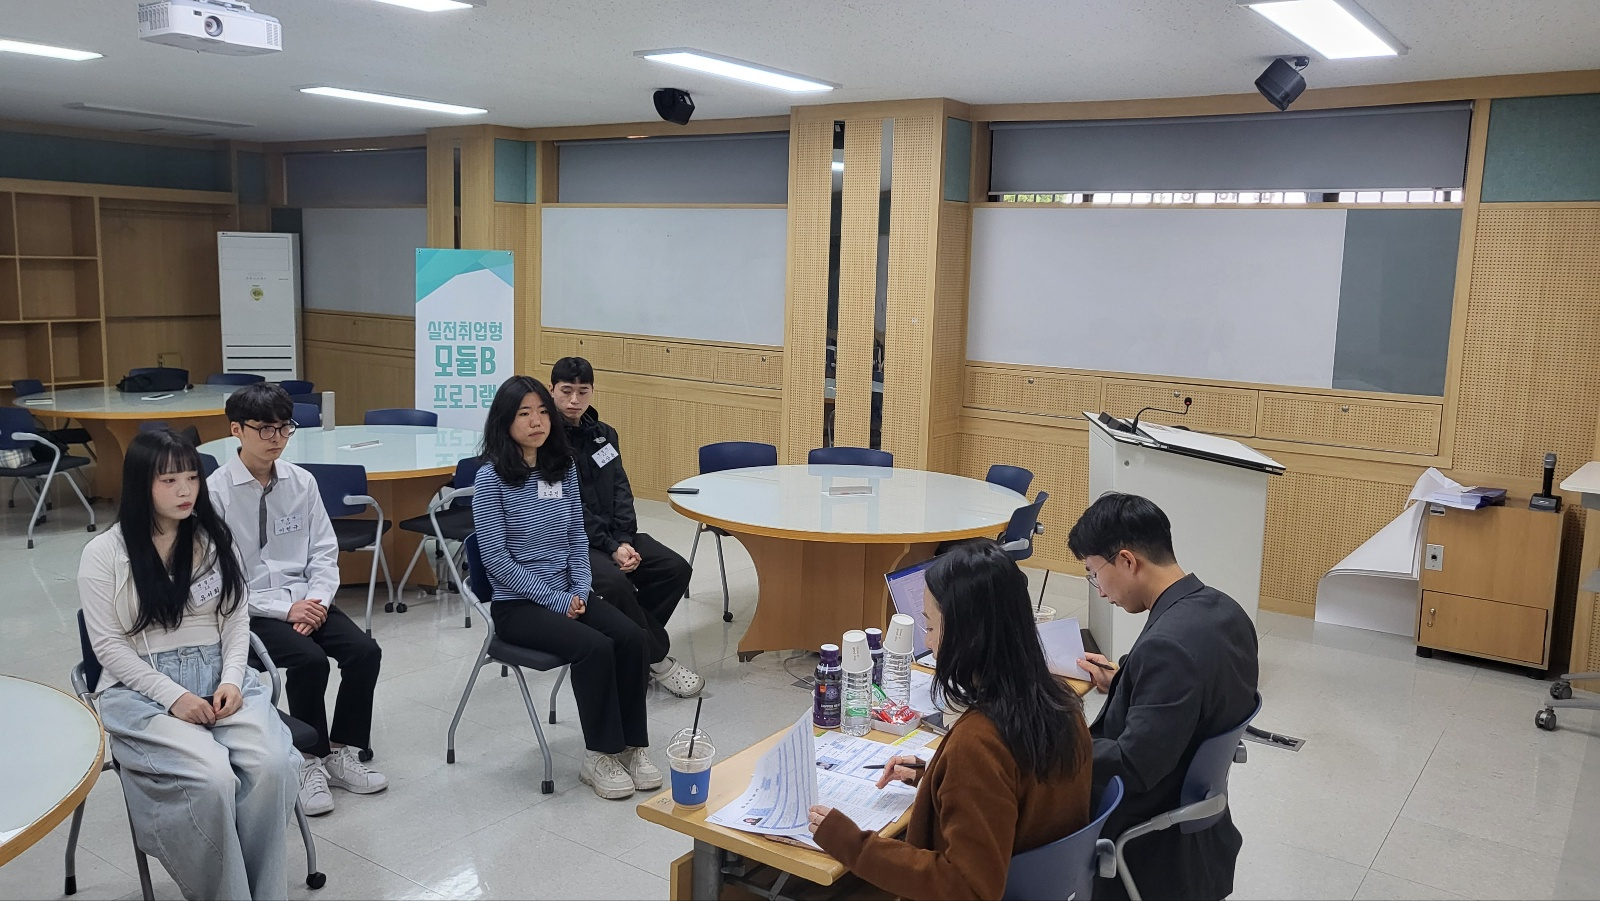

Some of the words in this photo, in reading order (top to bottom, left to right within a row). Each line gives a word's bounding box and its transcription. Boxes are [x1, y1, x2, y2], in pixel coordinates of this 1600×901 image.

[427, 320, 503, 341] 실전취업형
[434, 344, 497, 377] 모듈B
[433, 383, 497, 409] 프로그램
